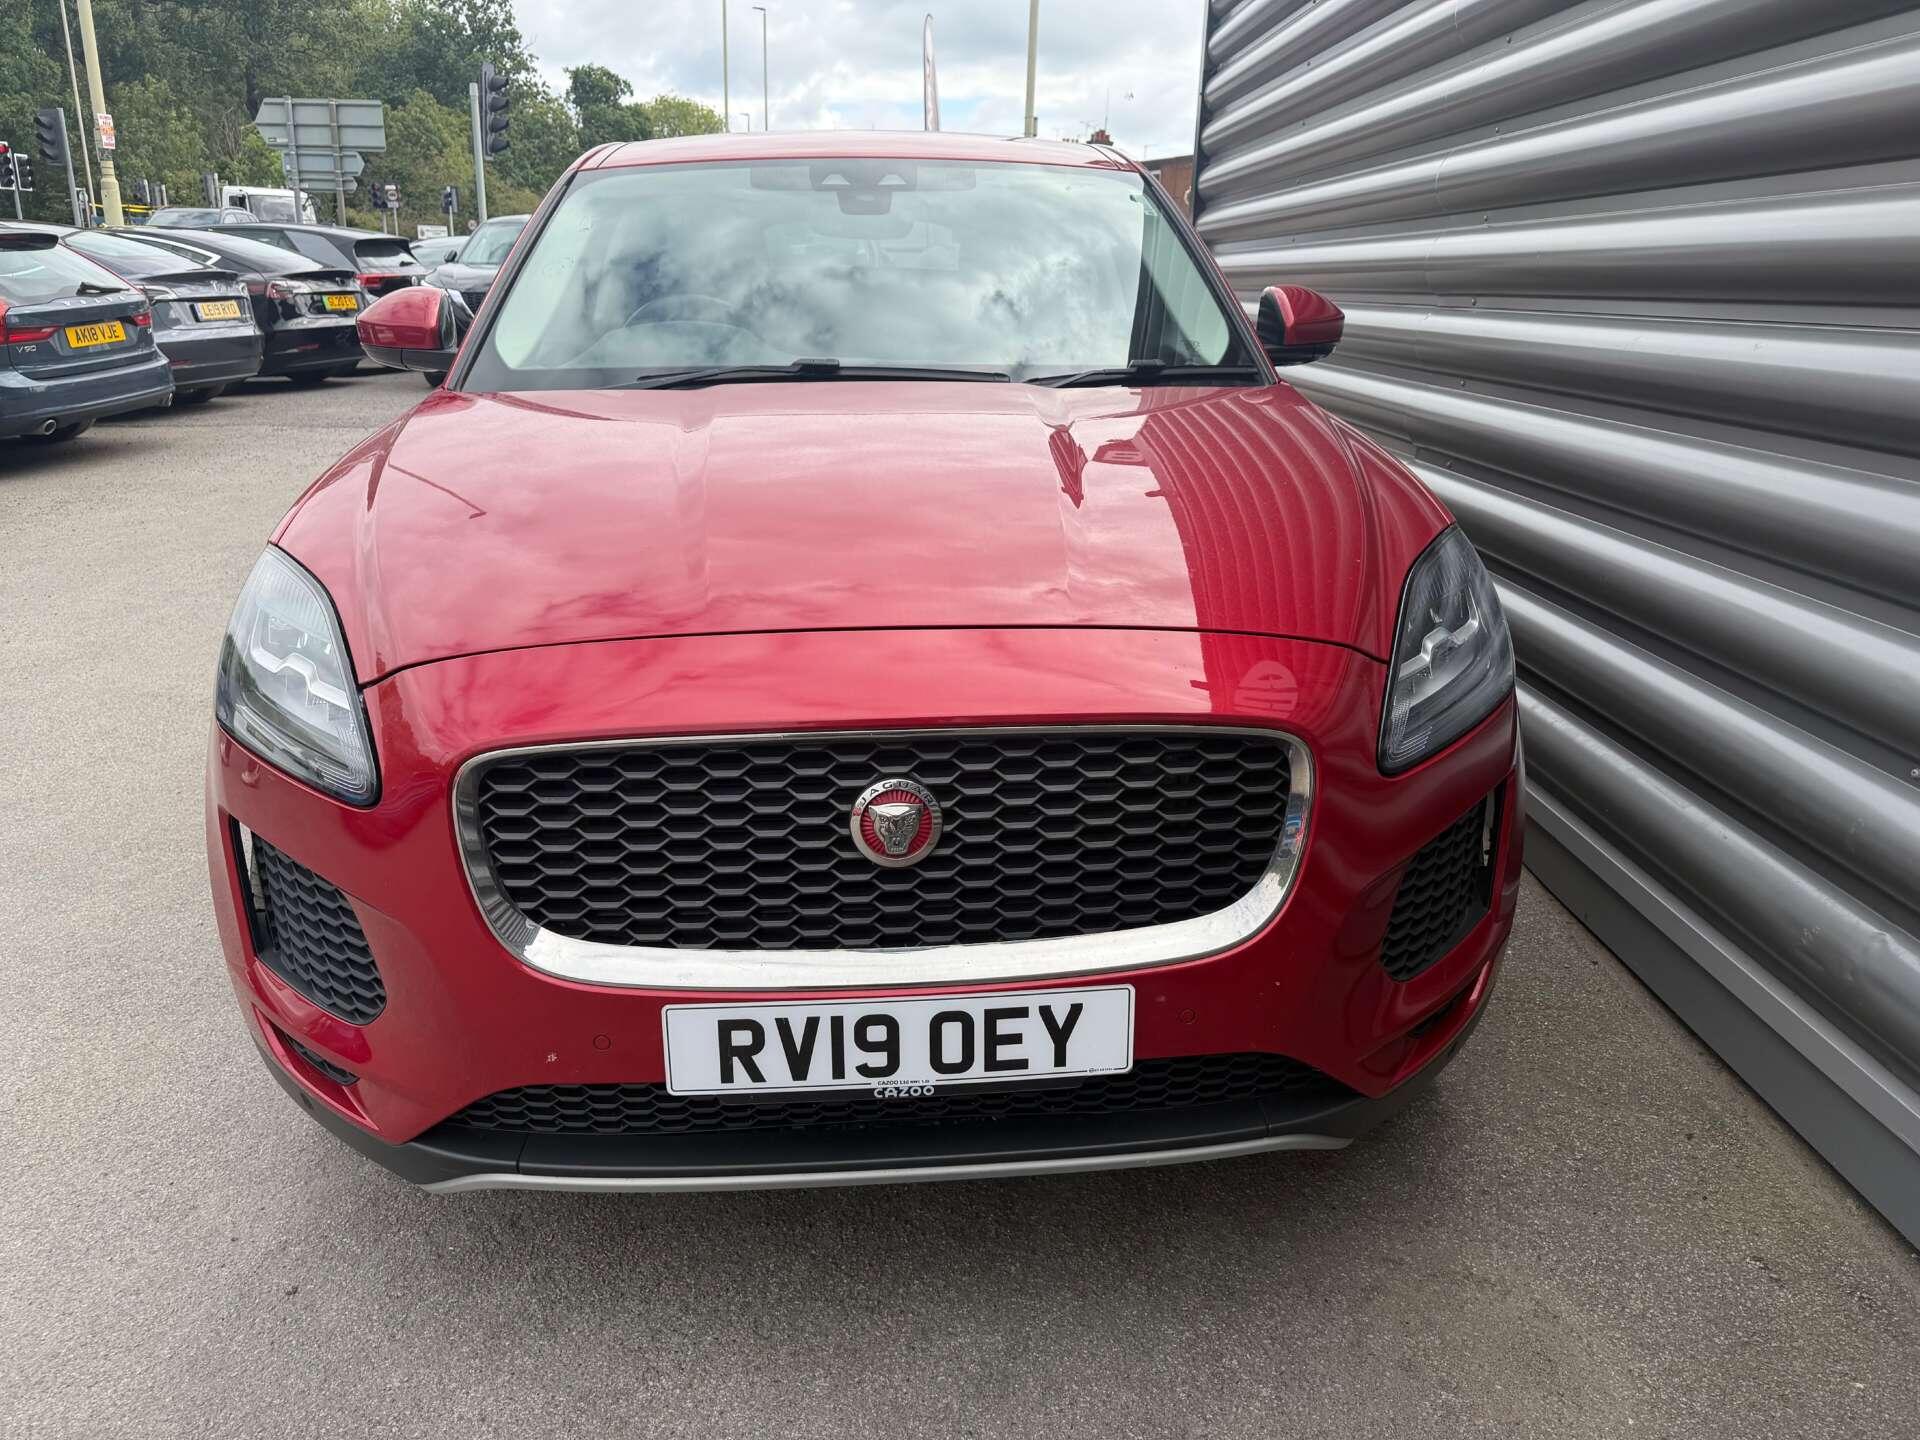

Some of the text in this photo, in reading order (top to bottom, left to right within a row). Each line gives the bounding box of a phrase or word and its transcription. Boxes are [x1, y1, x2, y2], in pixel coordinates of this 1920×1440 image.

[75, 324, 120, 344] AK18 VJE
[16, 344, 37, 353] V90
[717, 1002, 1084, 1084] RV19 OEY
[873, 1085, 935, 1098] CAZOO
